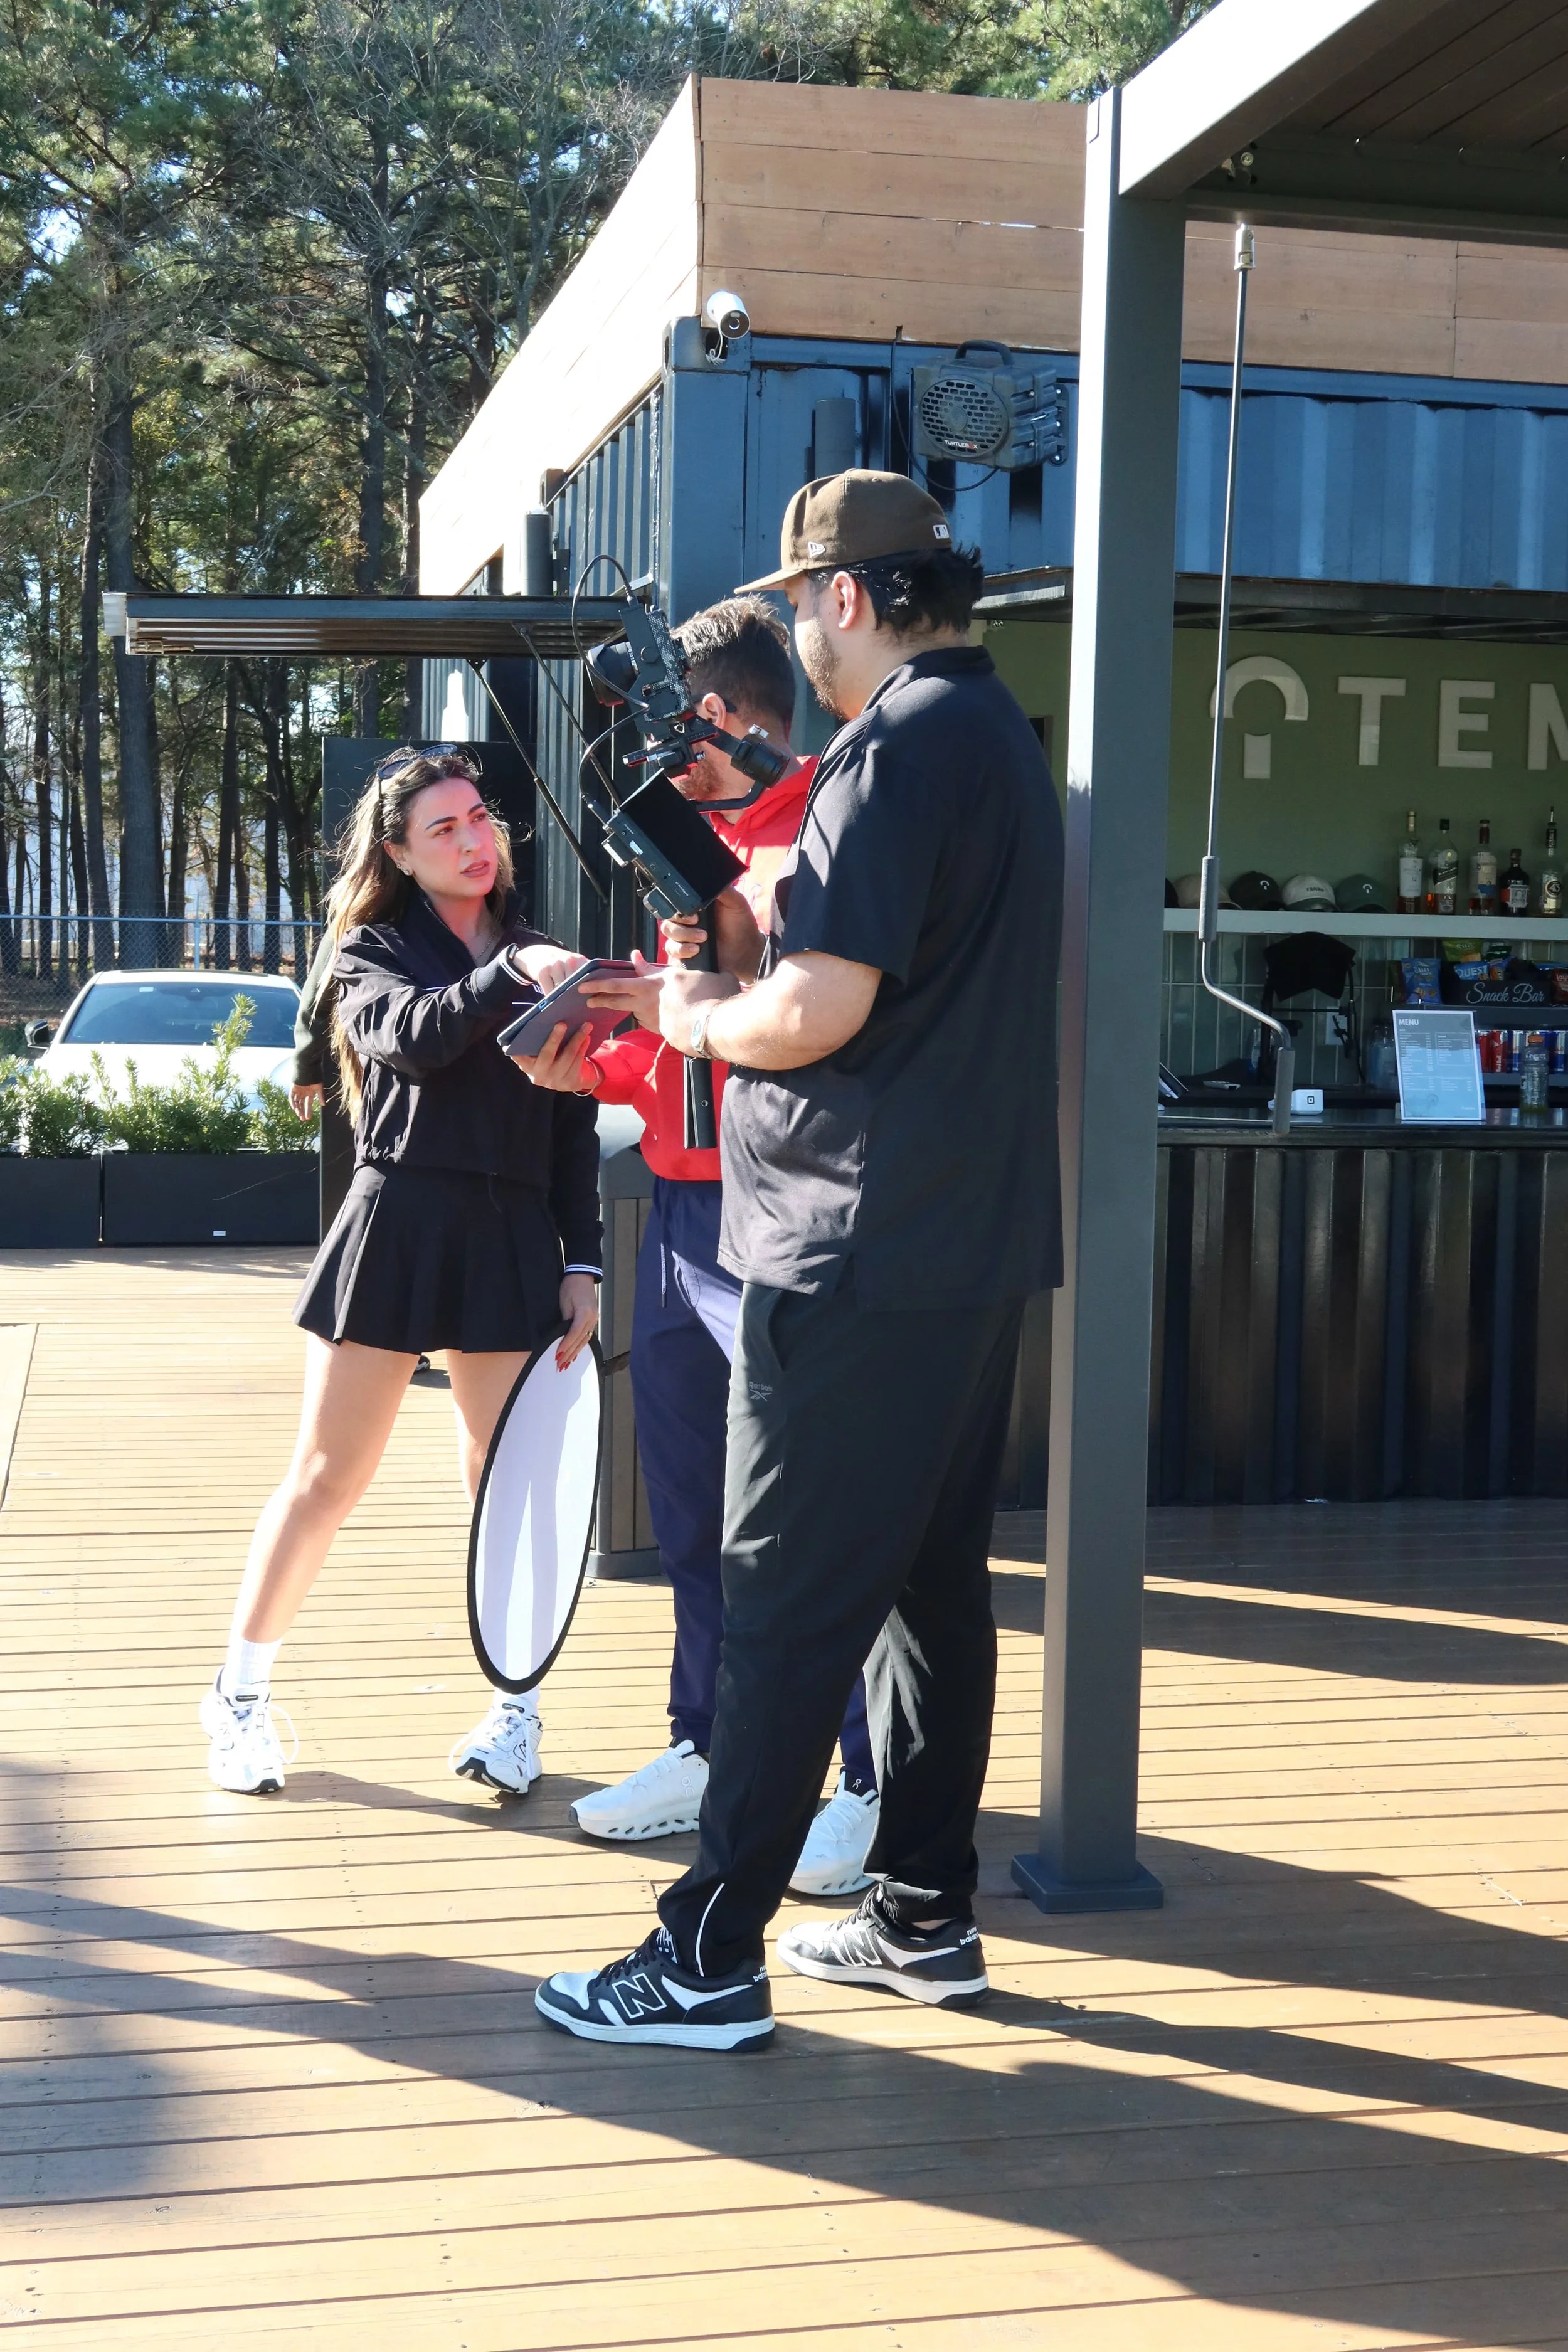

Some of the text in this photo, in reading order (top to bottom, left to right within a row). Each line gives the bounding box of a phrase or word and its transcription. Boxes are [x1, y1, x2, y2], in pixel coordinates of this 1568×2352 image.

[1466, 982, 1545, 1004] Snack Bar
[967, 1926, 977, 1936] new
[844, 1928, 882, 1967] N
[612, 1973, 667, 2018] N
